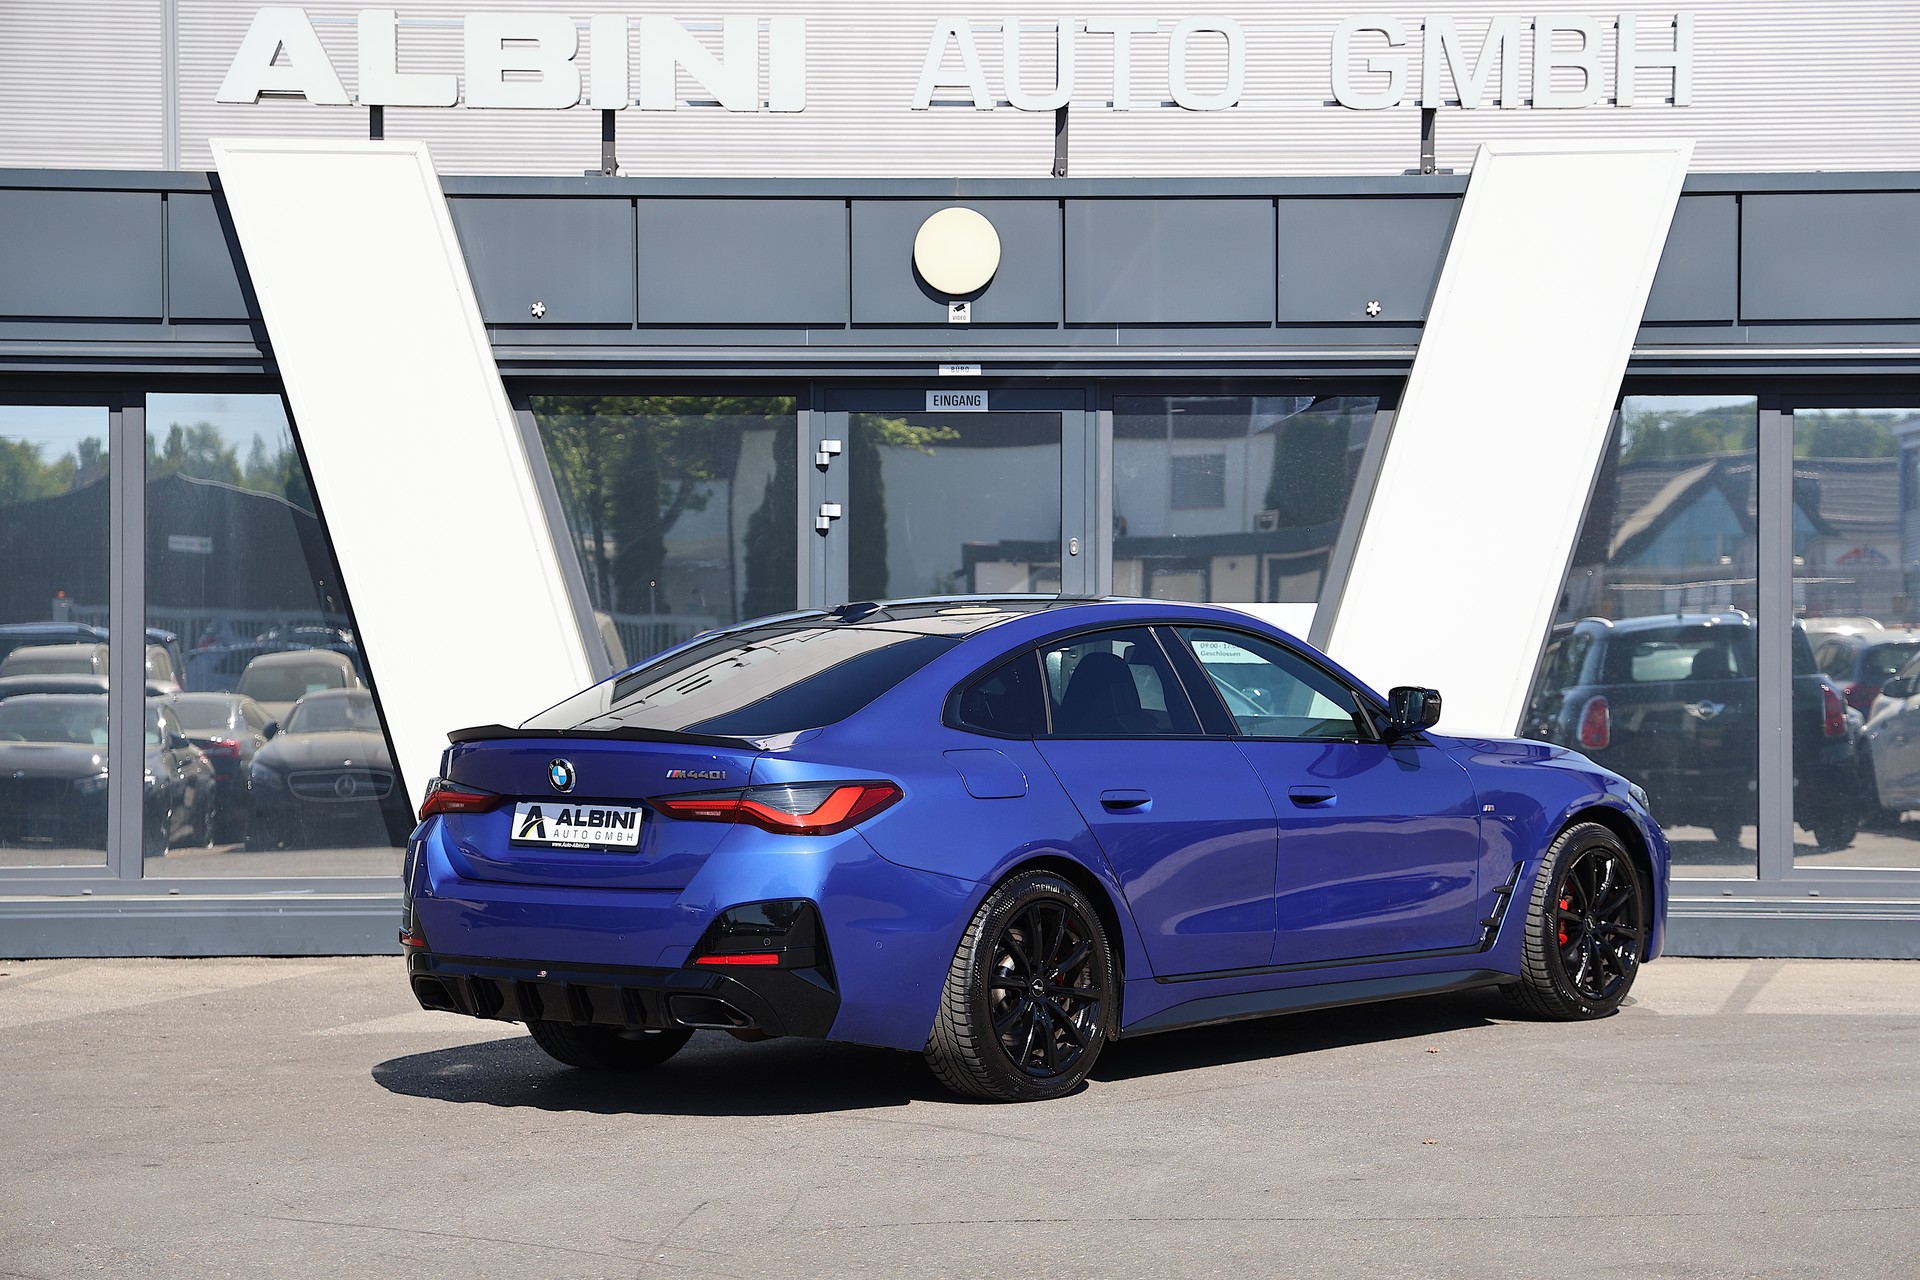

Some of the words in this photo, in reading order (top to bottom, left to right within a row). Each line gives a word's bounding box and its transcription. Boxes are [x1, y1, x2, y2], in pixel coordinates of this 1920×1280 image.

[215, 6, 807, 113] ALBINI
[910, 15, 1246, 112] AUTO
[1329, 12, 1696, 110] GMBH
[933, 395, 981, 406] EINGANG
[666, 769, 727, 780] M440i
[555, 807, 636, 829] ALBINI
[553, 829, 588, 839] AUTO
[594, 831, 634, 842] GMBH
